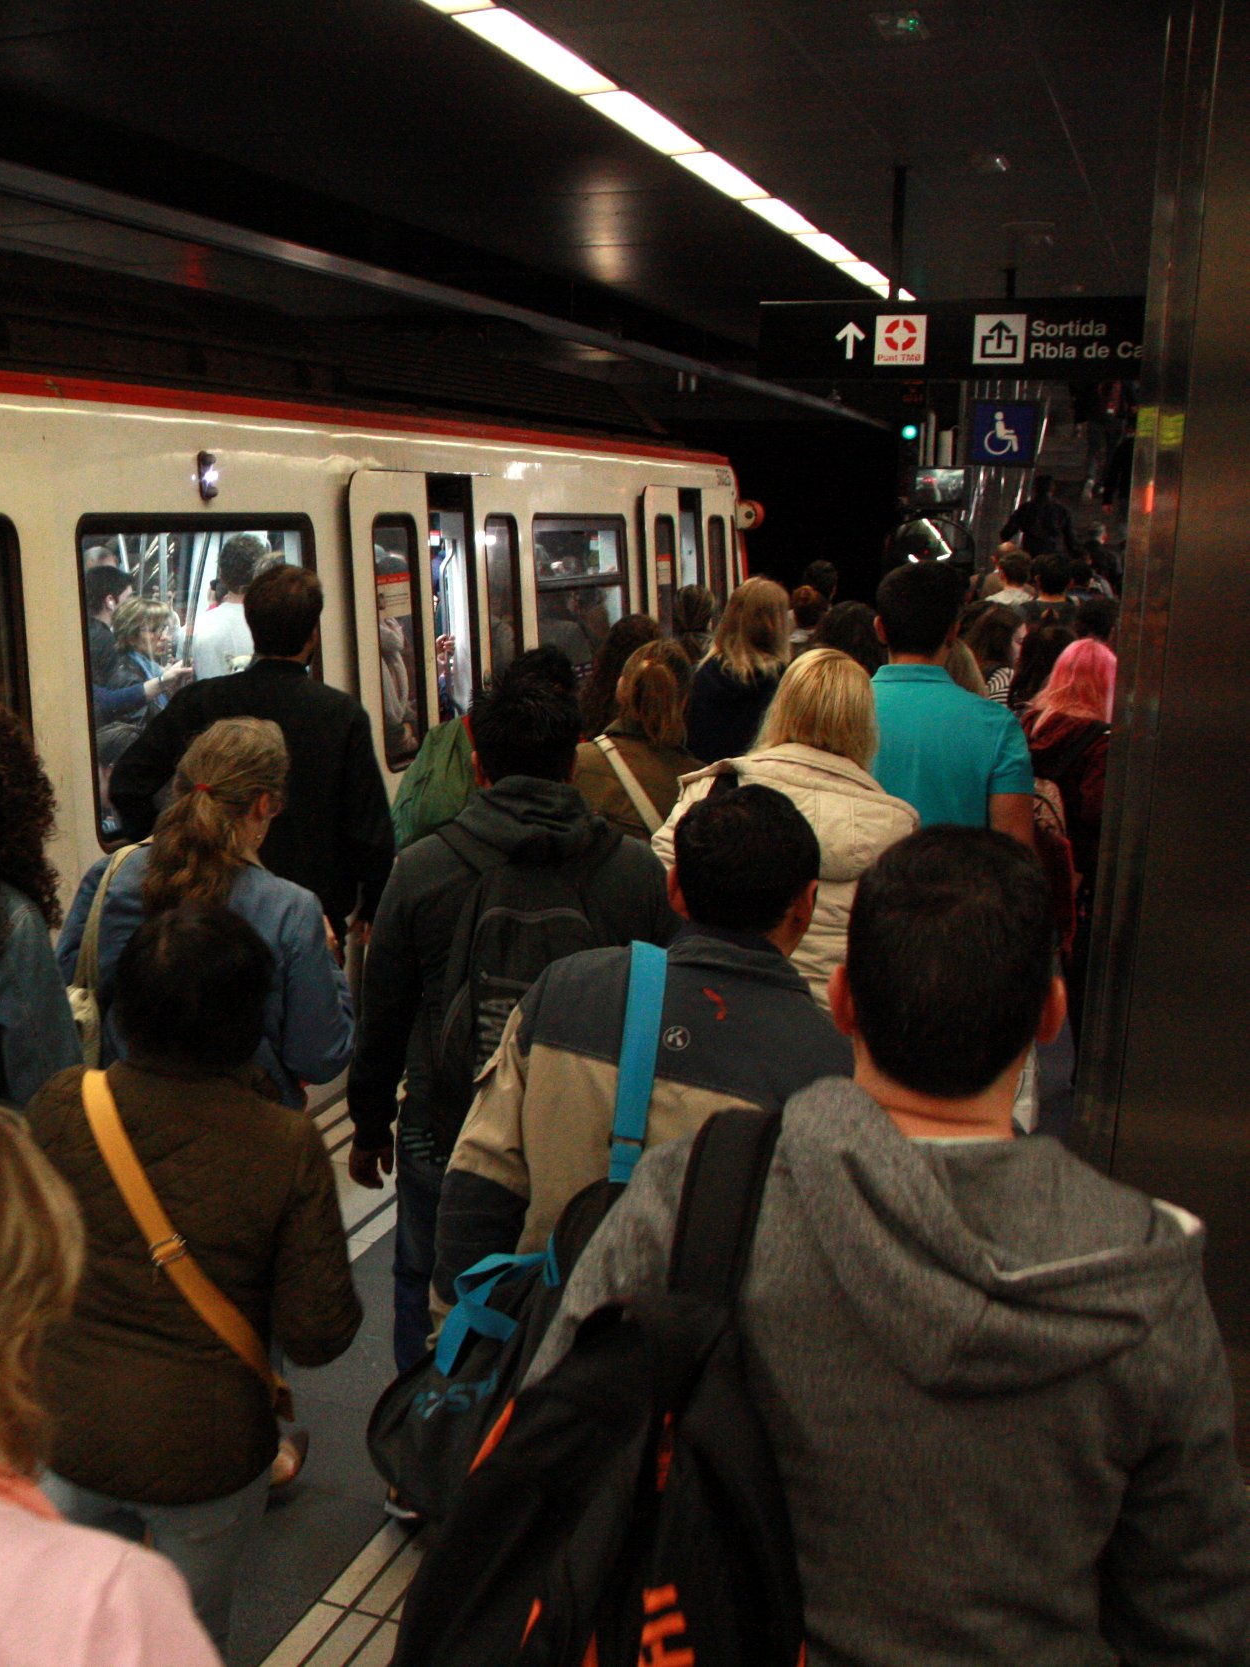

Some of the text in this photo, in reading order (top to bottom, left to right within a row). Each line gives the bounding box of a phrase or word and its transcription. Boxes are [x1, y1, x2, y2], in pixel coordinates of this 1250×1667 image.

[1031, 320, 1107, 337] Sortida
[1030, 342, 1077, 359] Rbla
[1084, 342, 1110, 358] de
